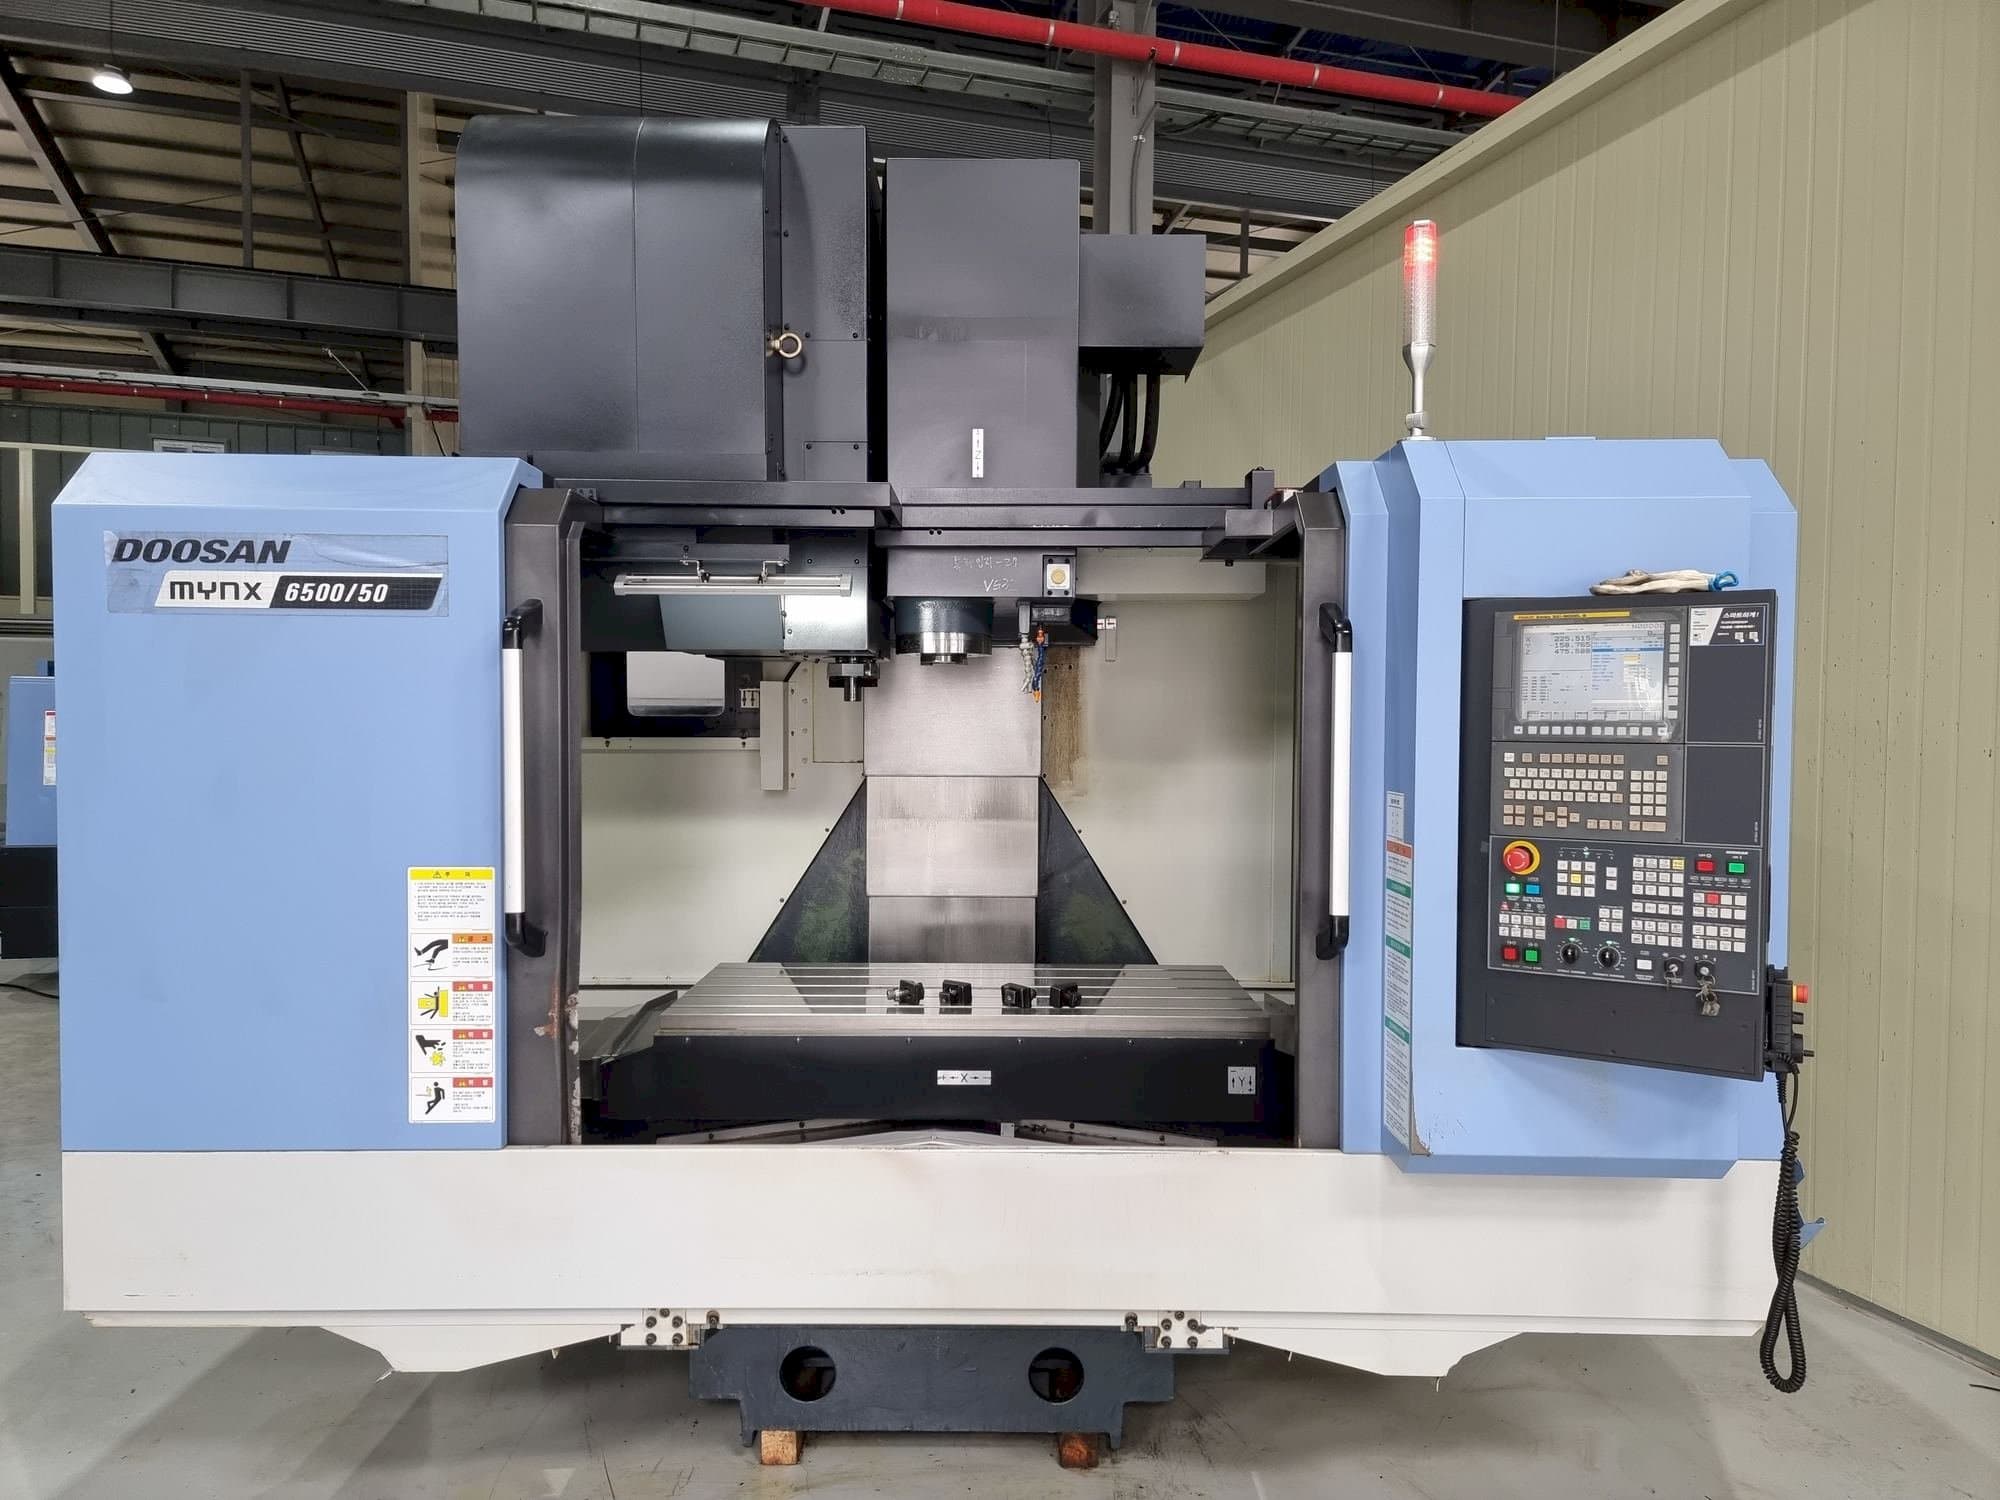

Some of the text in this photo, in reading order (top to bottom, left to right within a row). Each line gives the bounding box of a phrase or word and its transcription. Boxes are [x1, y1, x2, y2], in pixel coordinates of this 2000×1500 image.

[112, 538, 291, 564] DOOSAN
[284, 582, 389, 603] 6500/50
[960, 1072, 969, 1083] X
[1238, 1076, 1246, 1088] Y
